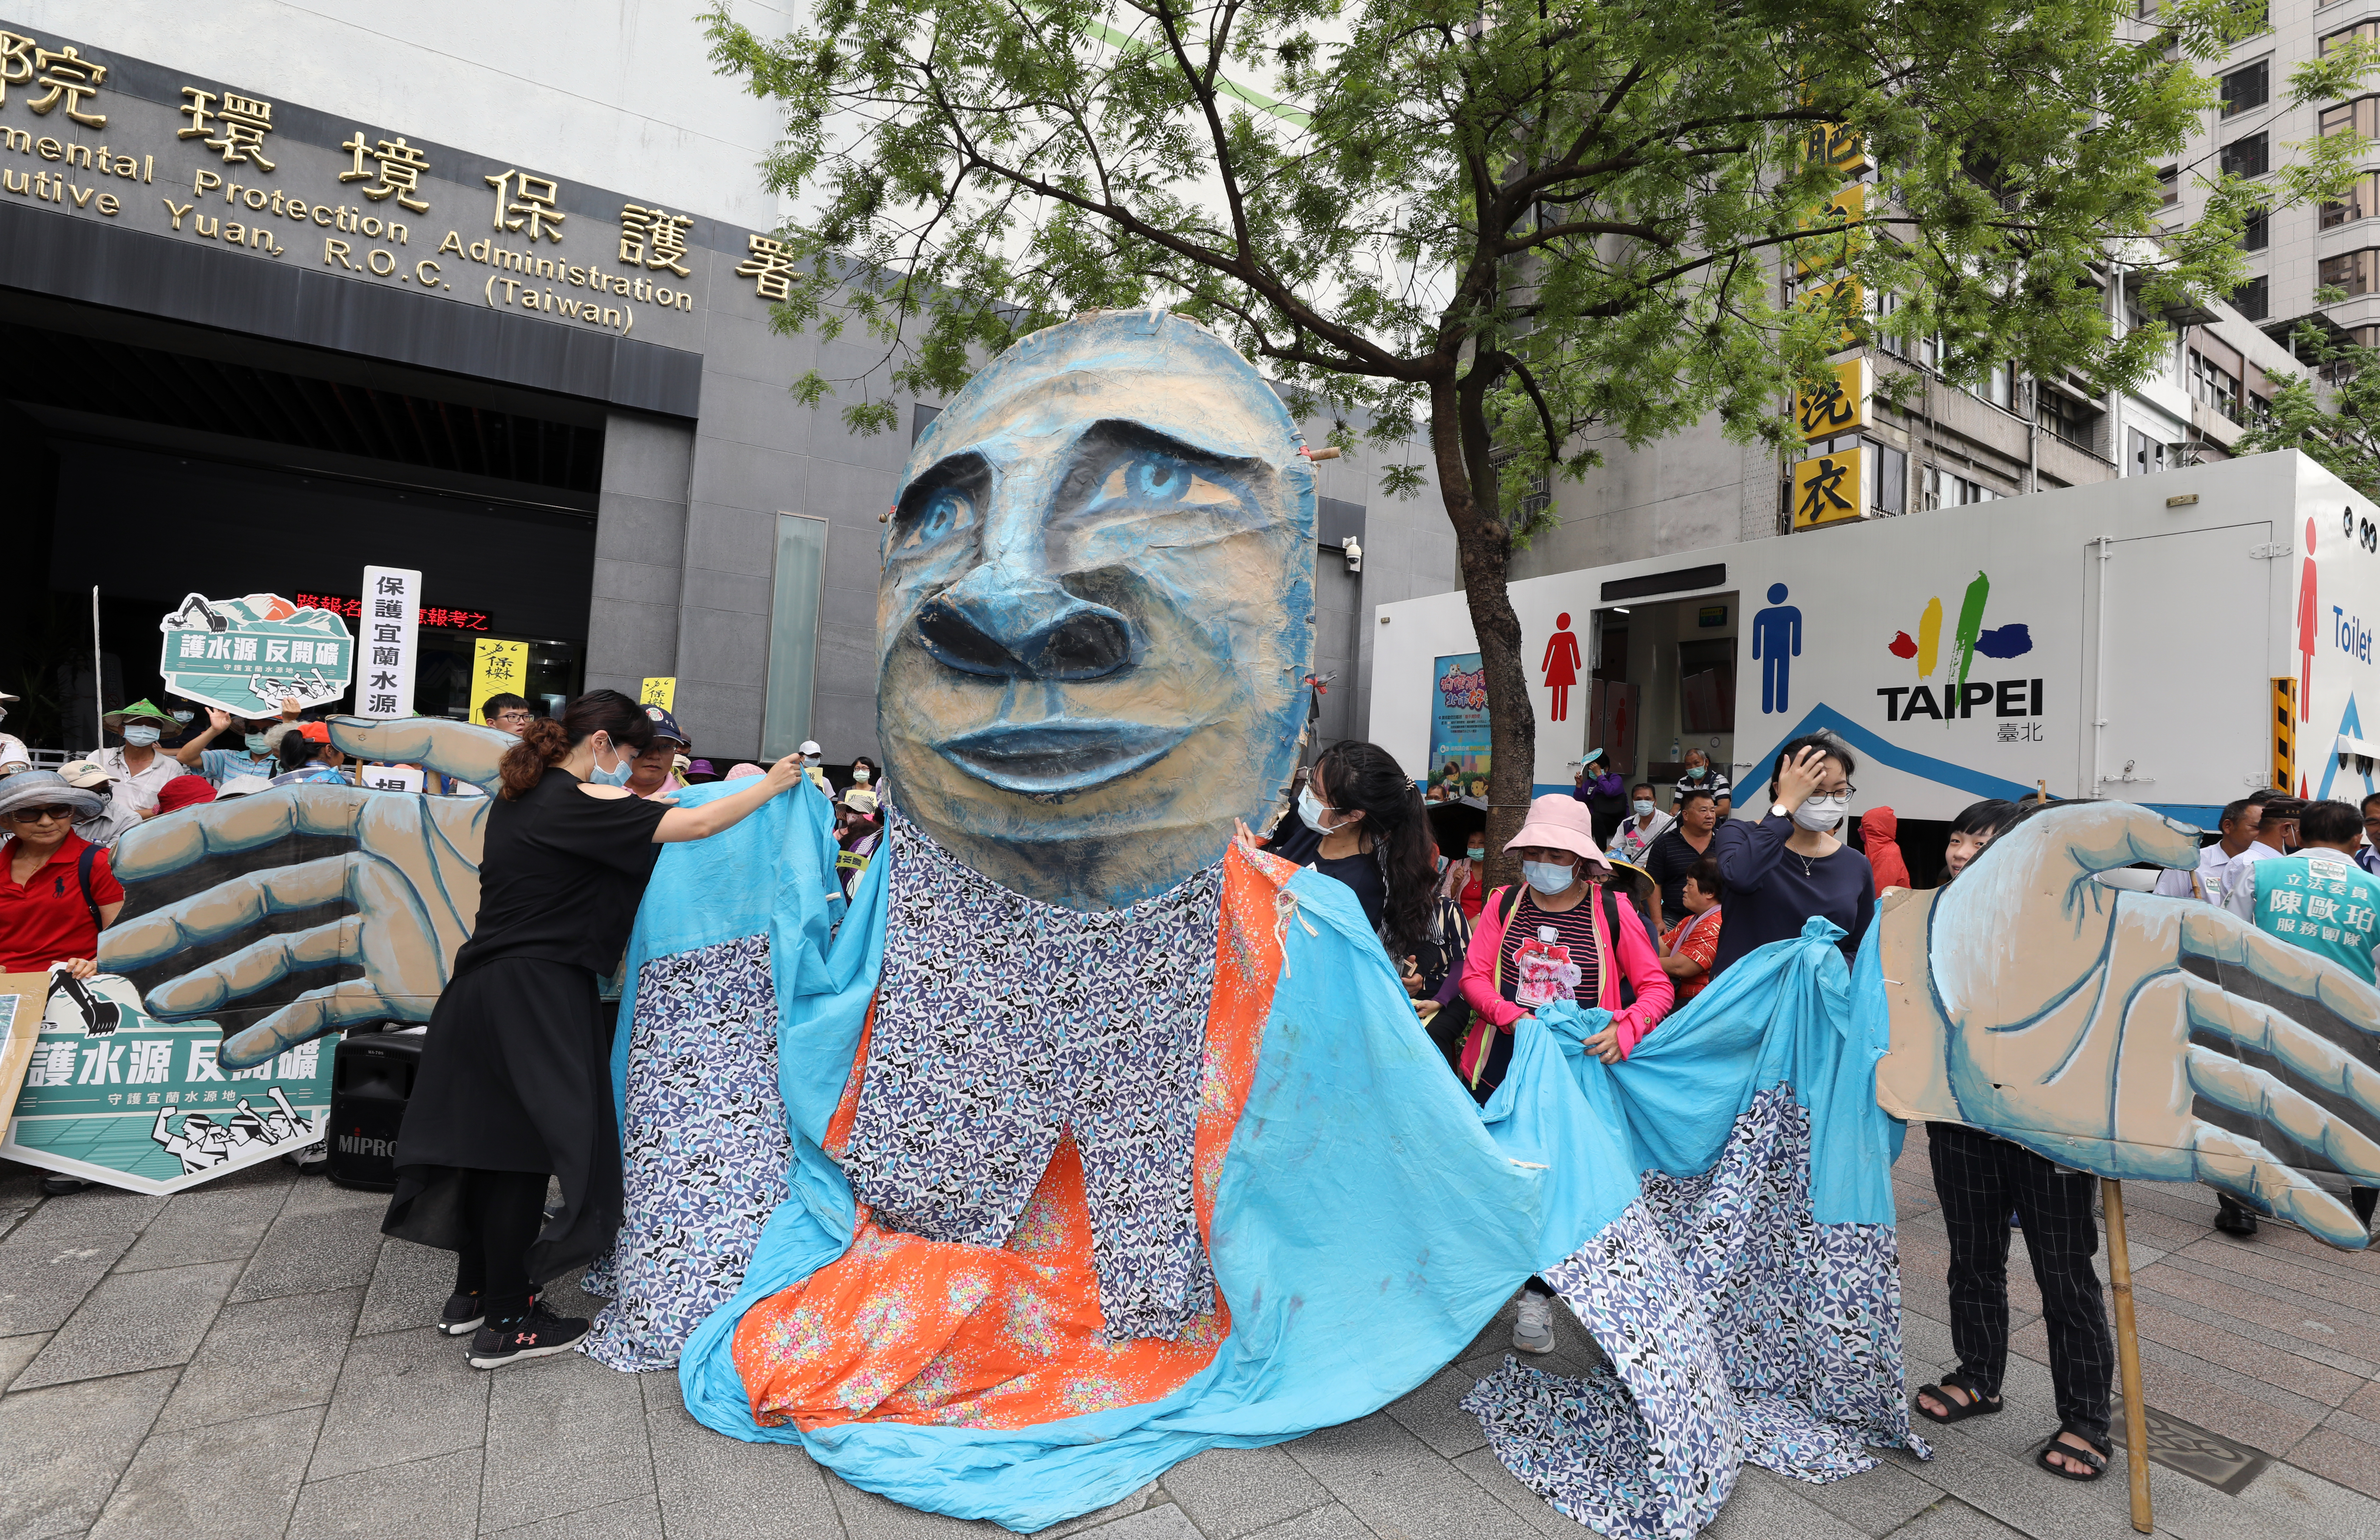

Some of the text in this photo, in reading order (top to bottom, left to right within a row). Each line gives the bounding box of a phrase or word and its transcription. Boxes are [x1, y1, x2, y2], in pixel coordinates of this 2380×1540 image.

[3, 168, 633, 336] utive Yuan, R.O.C. (Taiwan)
[194, 169, 408, 245] Protection
[438, 231, 692, 312] Administration
[179, 634, 339, 666] 護水源 反開礦
[368, 576, 404, 713] 保護宜蘭水源
[2333, 605, 2372, 665] Toilet
[223, 663, 294, 674] 守護宜蘭水源地
[1877, 679, 2043, 721] TAIPEI
[1997, 722, 2043, 742] 臺北
[2284, 873, 2368, 901] 立法委員
[2270, 889, 2376, 933] 陳歐珀
[2276, 918, 2362, 947] 服務團隊
[26, 1040, 173, 1087] 護水源
[108, 1090, 236, 1105] 守護宜蘭水源地
